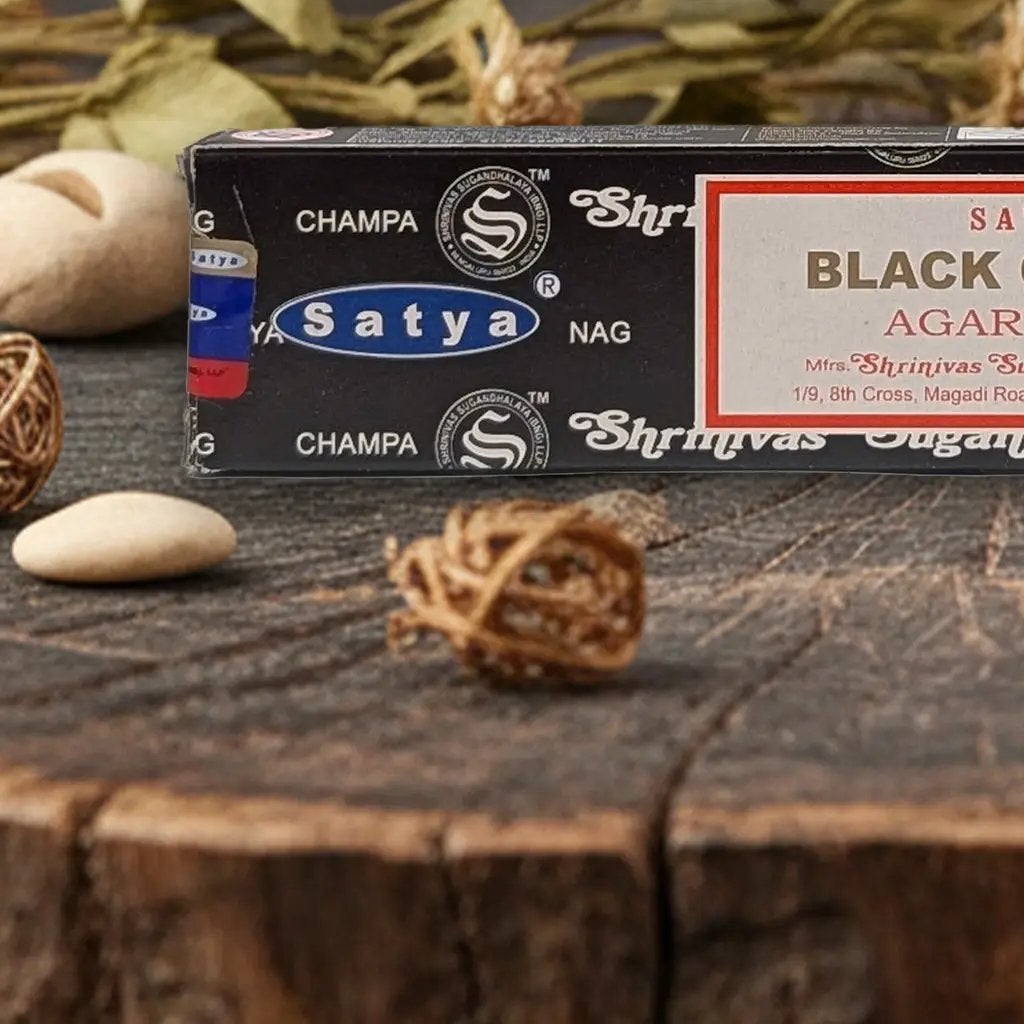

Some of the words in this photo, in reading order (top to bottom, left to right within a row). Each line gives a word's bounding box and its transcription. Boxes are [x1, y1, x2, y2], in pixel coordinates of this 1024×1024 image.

[296, 209, 419, 233] CHAMPA
[807, 251, 1001, 289] BLACK
[303, 302, 519, 346] Satya
[569, 321, 631, 344] NAG
[805, 358, 850, 372] Mfrs.
[850, 352, 983, 378] Shrinivas
[793, 386, 823, 403] 1/9,
[829, 386, 856, 402] 8th
[862, 386, 918, 403] Cross,
[924, 386, 988, 406] Magadi
[296, 431, 418, 455] CHAMPA
